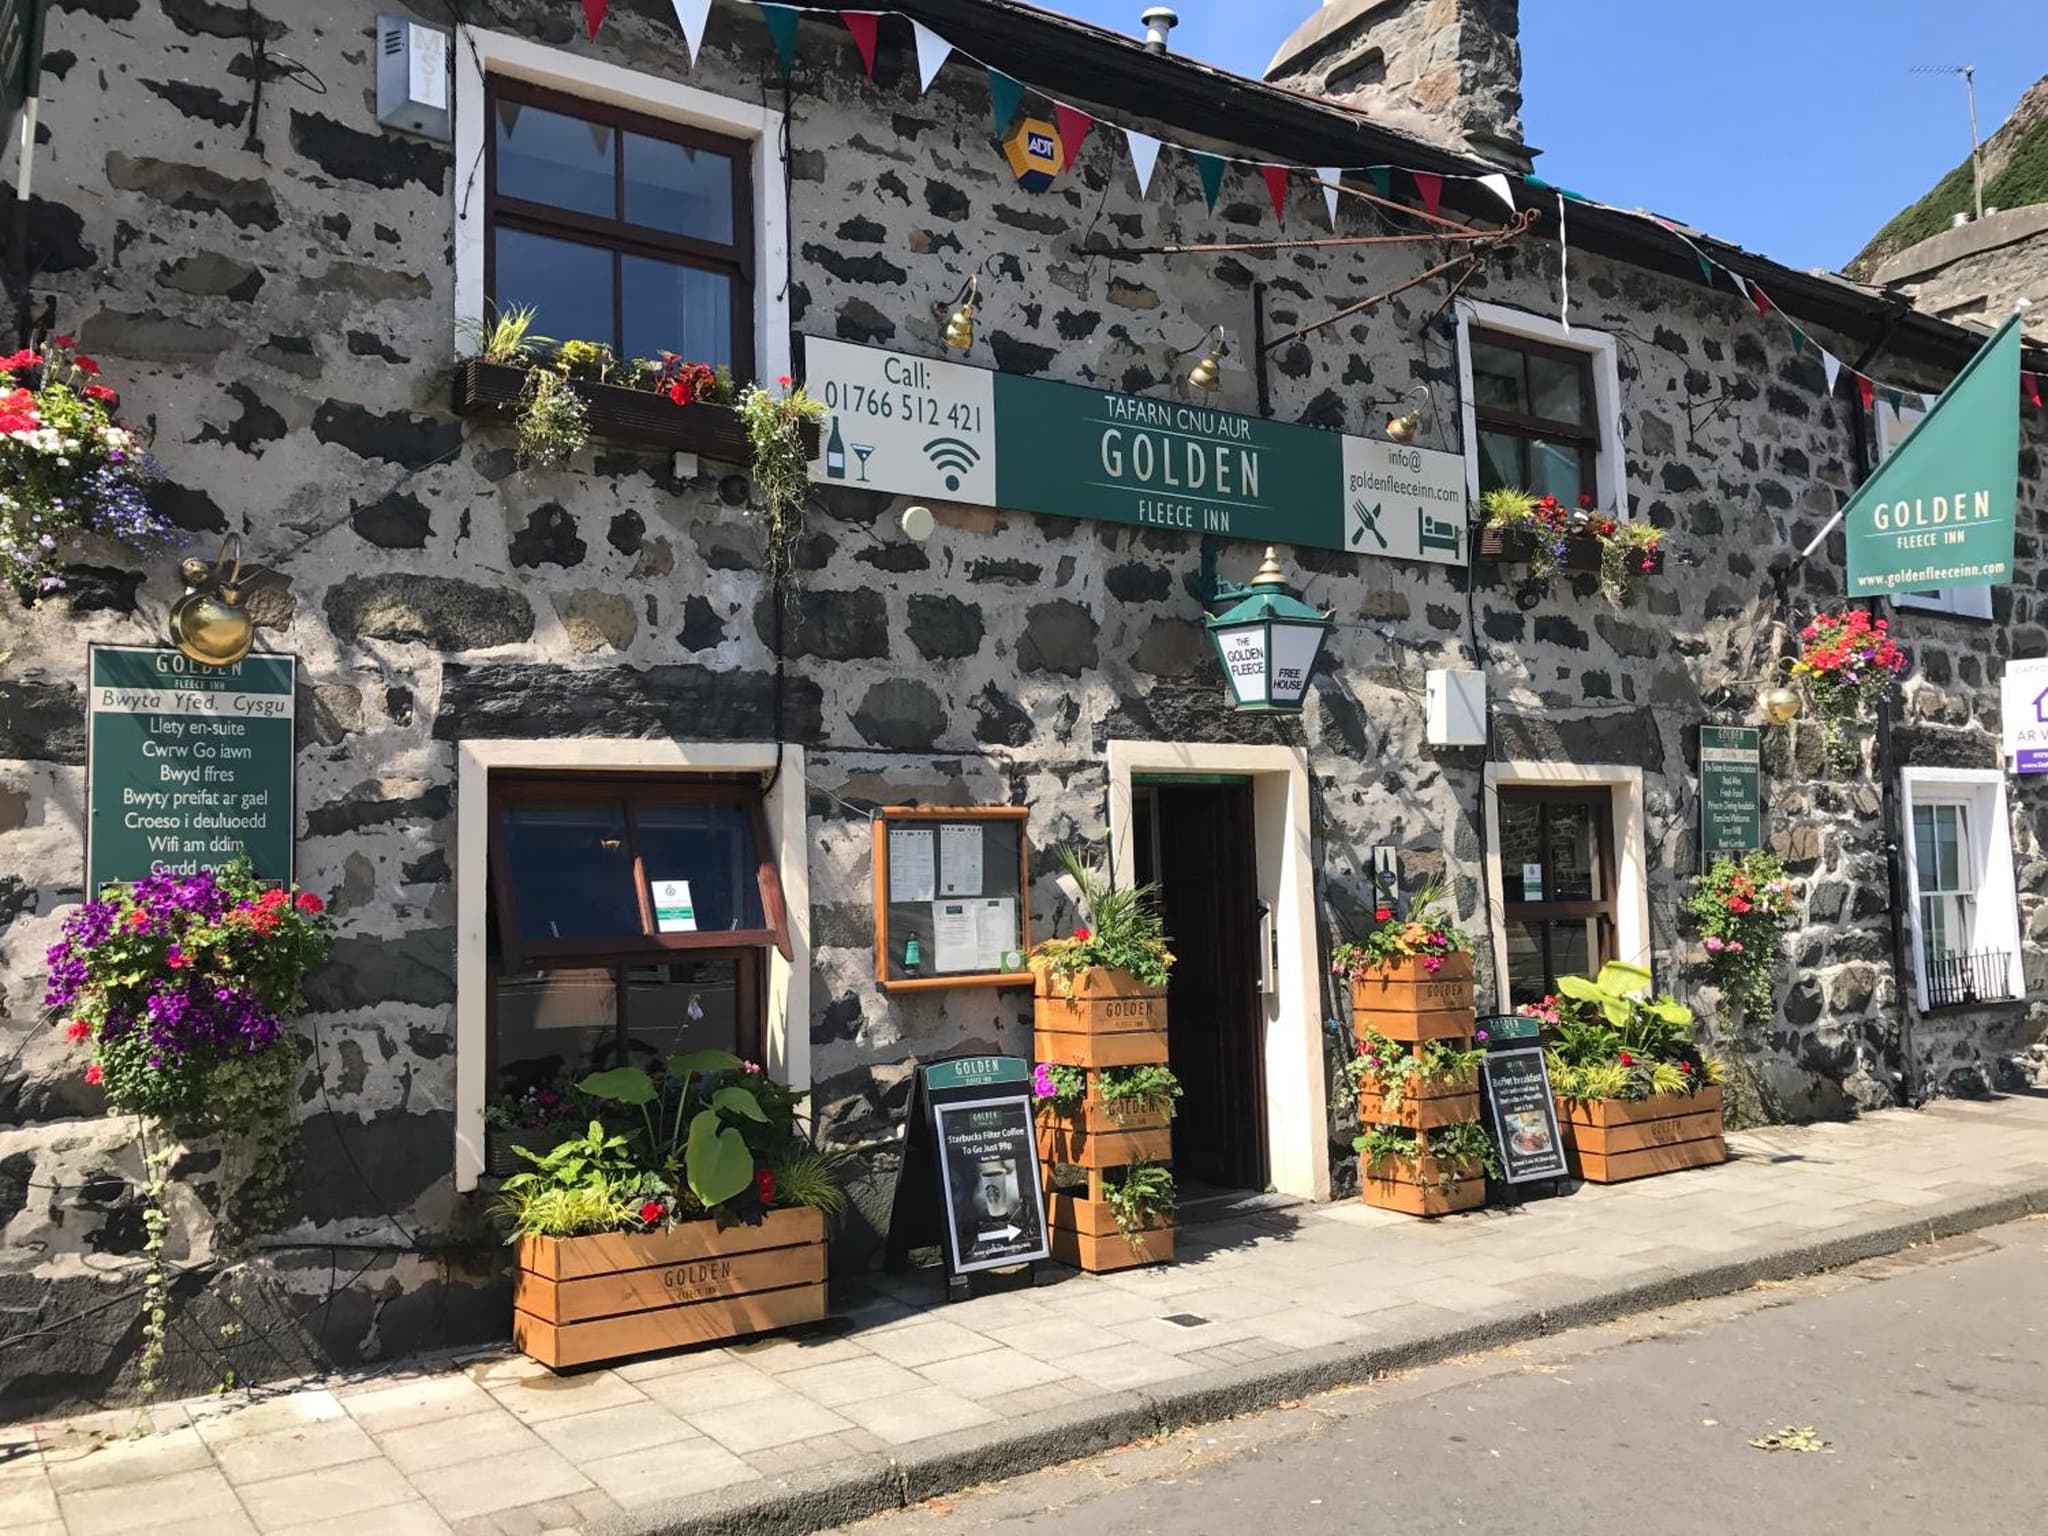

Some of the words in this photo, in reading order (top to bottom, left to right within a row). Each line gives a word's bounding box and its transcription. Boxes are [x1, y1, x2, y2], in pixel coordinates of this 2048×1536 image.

[1028, 136, 1054, 157] ADT
[884, 357, 931, 390] Call:
[825, 380, 892, 417] 01766
[901, 394, 940, 426] 512
[947, 403, 981, 432] 421
[1104, 395, 1172, 427] TAFARN
[1177, 409, 1214, 434] CNU
[1218, 416, 1251, 440] AUR
[1101, 428, 1259, 498] GOLDEN
[1388, 449, 1422, 473] info@
[1350, 471, 1459, 503] goldenfleeceinn.com
[1139, 500, 1193, 528] FLEECE
[1203, 508, 1230, 532] INN
[1874, 490, 1989, 530] GOLDEN
[1897, 532, 1937, 549] FLEECE
[1944, 530, 1965, 545] INN
[1857, 562, 2006, 588] www.goldenfleeceinn.com
[1235, 637, 1250, 646] THE
[1227, 647, 1264, 662] GOLDEN
[1231, 661, 1265, 676] FLEECE
[1278, 668, 1301, 679] FREE
[1273, 680, 1303, 690] HOUSE
[102, 690, 161, 711] Bwyta
[233, 695, 285, 716] Cysgu
[150, 717, 184, 738] Llety
[189, 719, 245, 736] en-suite
[2016, 729, 2036, 742] AR
[142, 740, 188, 757] Cwrw
[193, 742, 216, 759] Go
[220, 744, 251, 759] iawn
[160, 764, 200, 785] Bwyd
[204, 766, 234, 782] ffres
[123, 788, 169, 809] Bwyty
[173, 789, 219, 809] preifat
[223, 793, 237, 805] ar
[241, 790, 268, 810] gael
[124, 812, 180, 829] Croeso
[193, 812, 266, 829] deuluoedd
[148, 835, 179, 852] Wifi
[183, 840, 205, 852] am
[210, 835, 244, 853] ddim
[150, 859, 197, 876] Gardd
[1106, 1000, 1153, 1018] GOLDEN
[955, 1058, 999, 1076] GOLDEN
[947, 1131, 982, 1144] Starbucks
[1001, 1127, 1025, 1137] Coffee
[962, 1146, 972, 1155] To
[972, 1145, 983, 1154] Go
[984, 1143, 998, 1153] Just
[664, 1261, 731, 1288] GOLDEN
